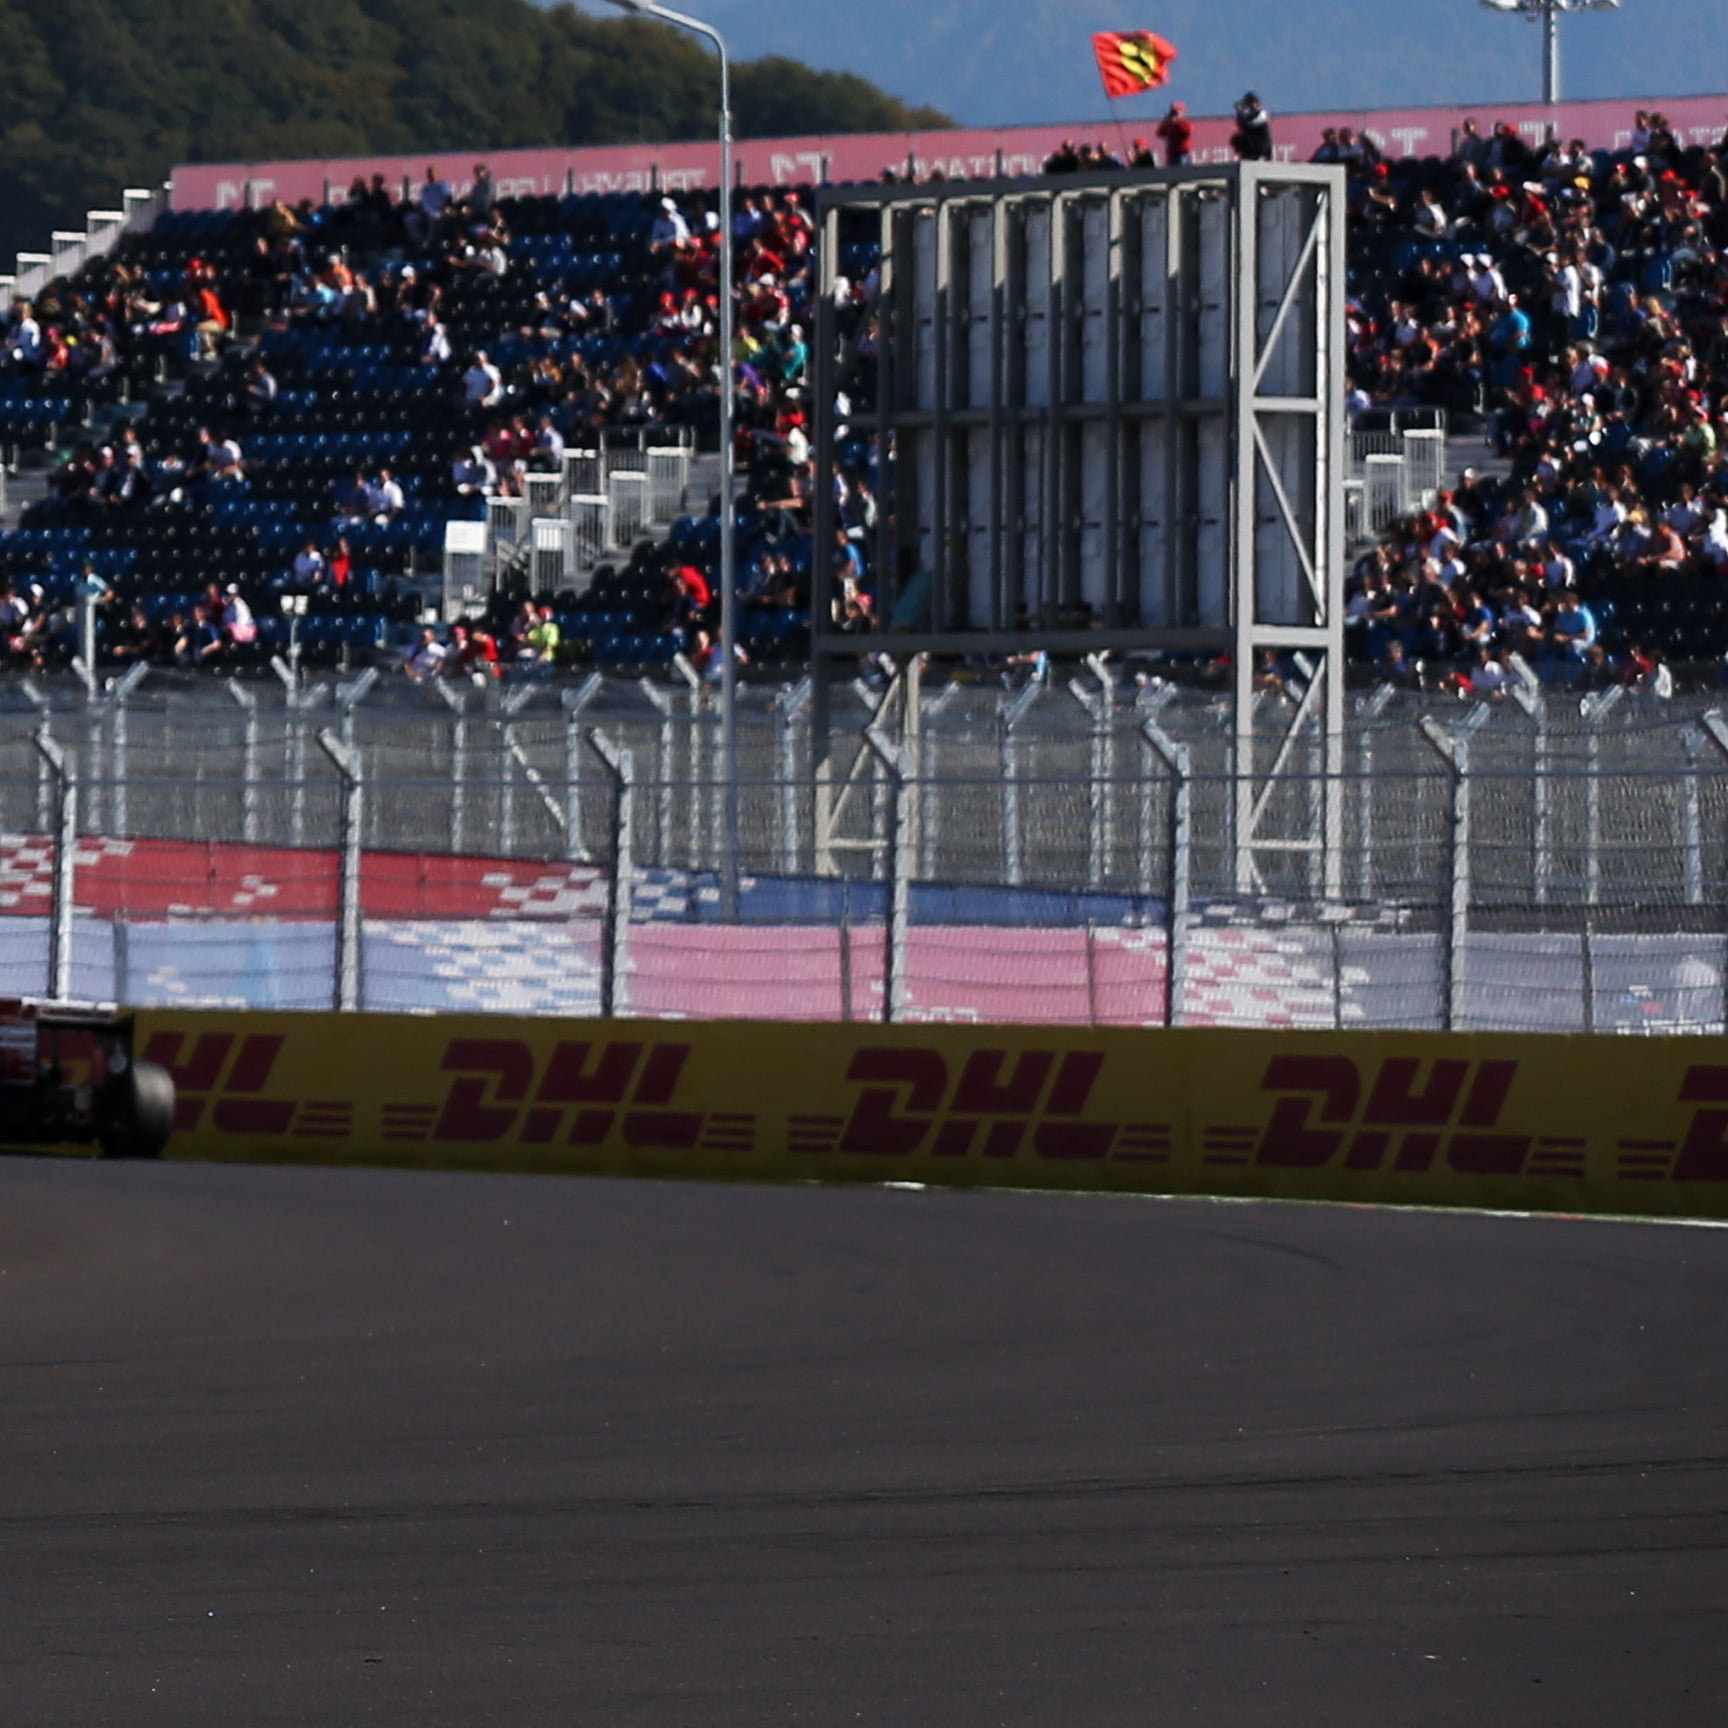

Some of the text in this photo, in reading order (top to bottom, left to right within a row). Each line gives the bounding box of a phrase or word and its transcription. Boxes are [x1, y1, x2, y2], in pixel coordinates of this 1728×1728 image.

[434, 1038, 707, 1149] DHL
[837, 1046, 1121, 1160] DHL
[1254, 1055, 1532, 1172] DHL
